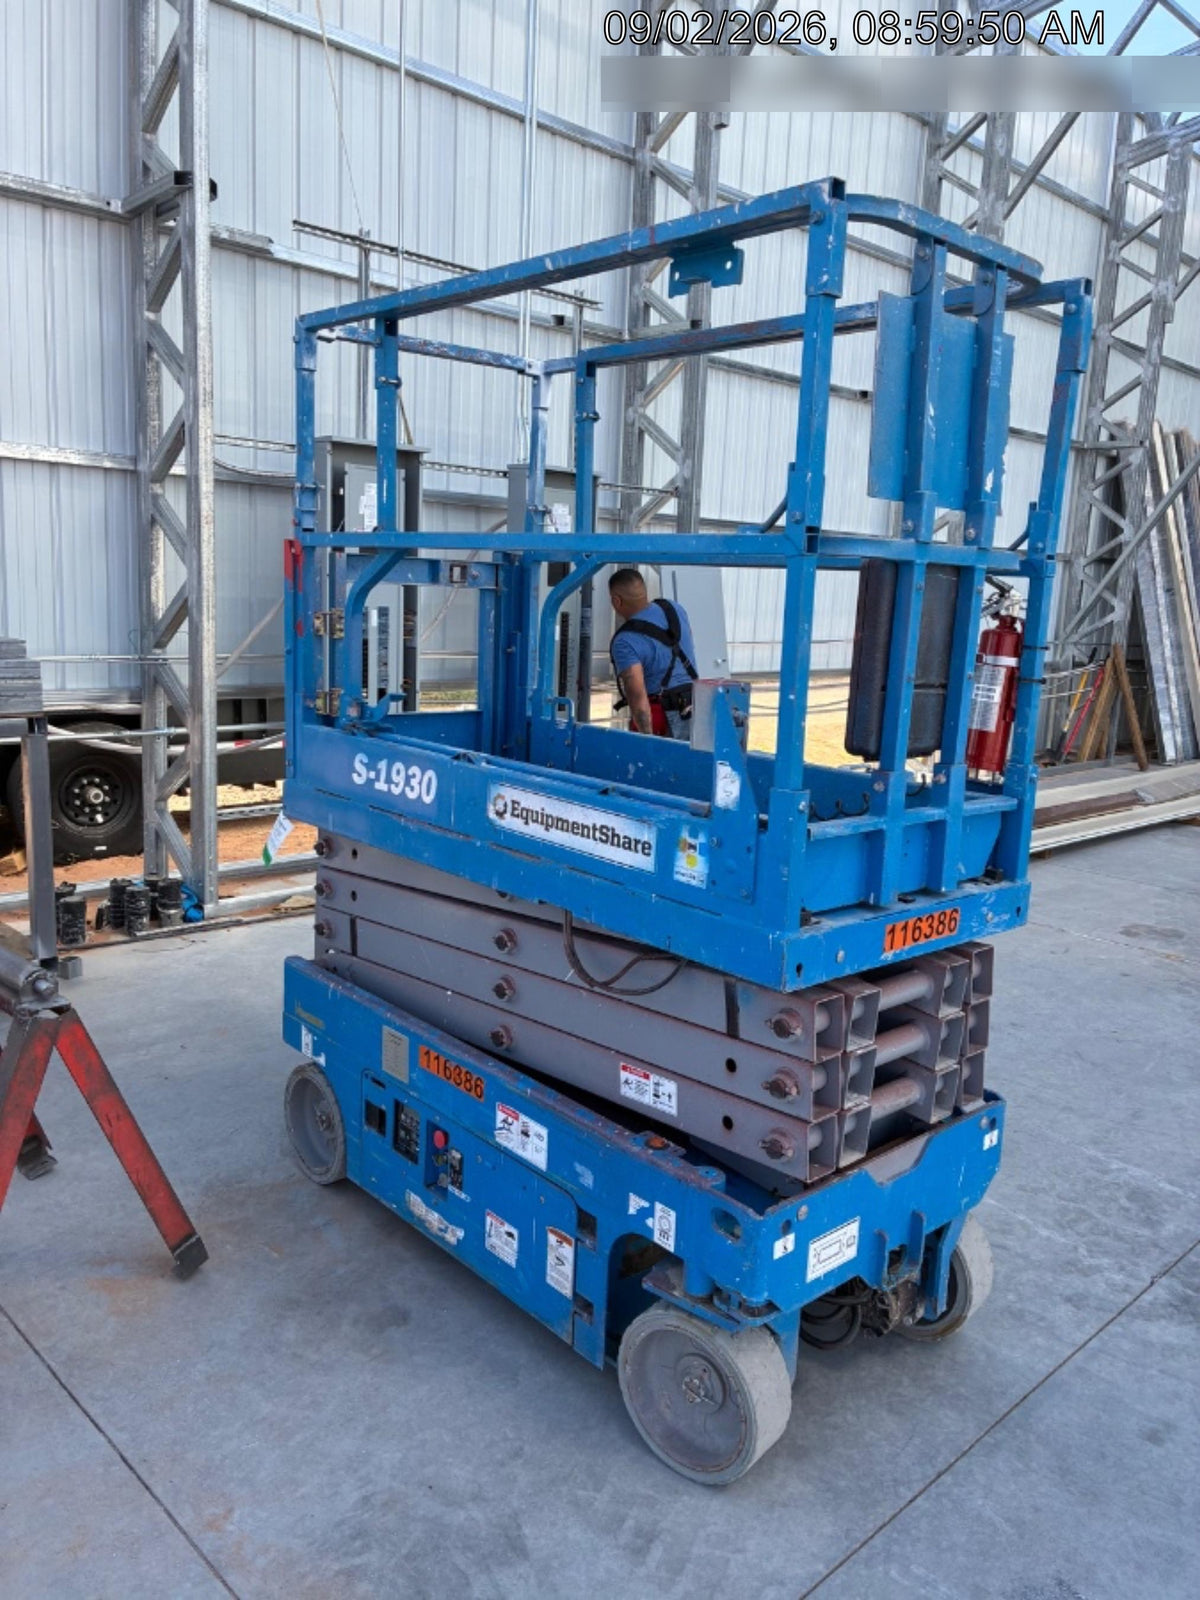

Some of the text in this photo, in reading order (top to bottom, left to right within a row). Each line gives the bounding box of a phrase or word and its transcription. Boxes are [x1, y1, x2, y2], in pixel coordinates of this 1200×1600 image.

[351, 752, 438, 805] S-1930
[510, 799, 652, 856] EquipmentShare
[886, 908, 959, 950] 116386
[424, 1049, 484, 1099] 116386
